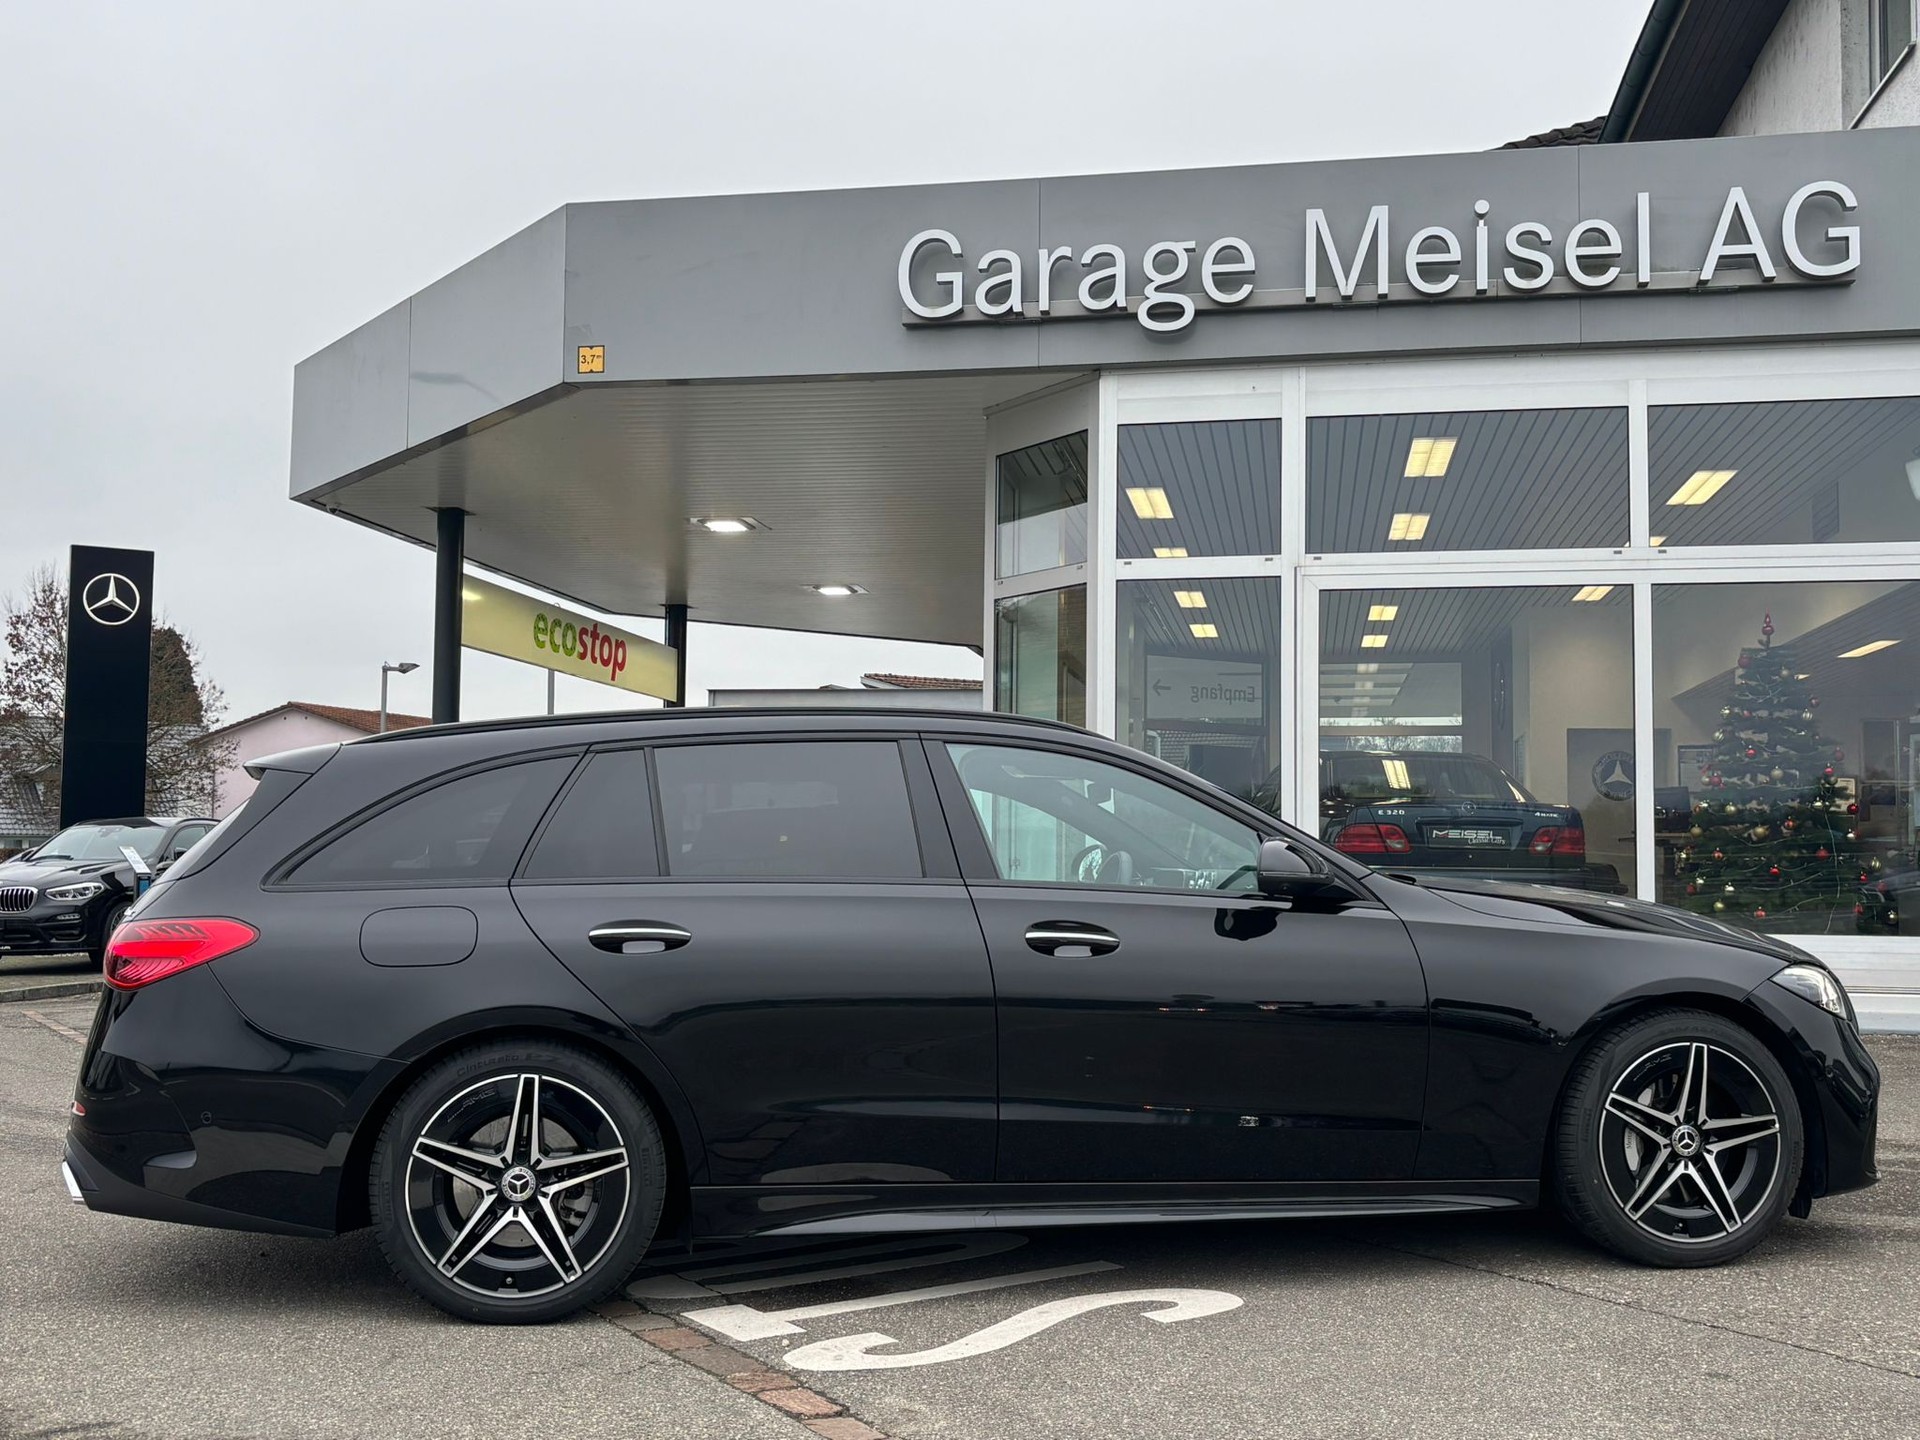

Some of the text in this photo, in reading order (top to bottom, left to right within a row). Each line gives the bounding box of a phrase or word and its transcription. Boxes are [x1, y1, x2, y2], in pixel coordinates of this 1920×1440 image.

[898, 181, 1861, 333] Garage Meisel AG
[533, 613, 628, 682] ecostop
[1432, 829, 1502, 839] MEISEL
